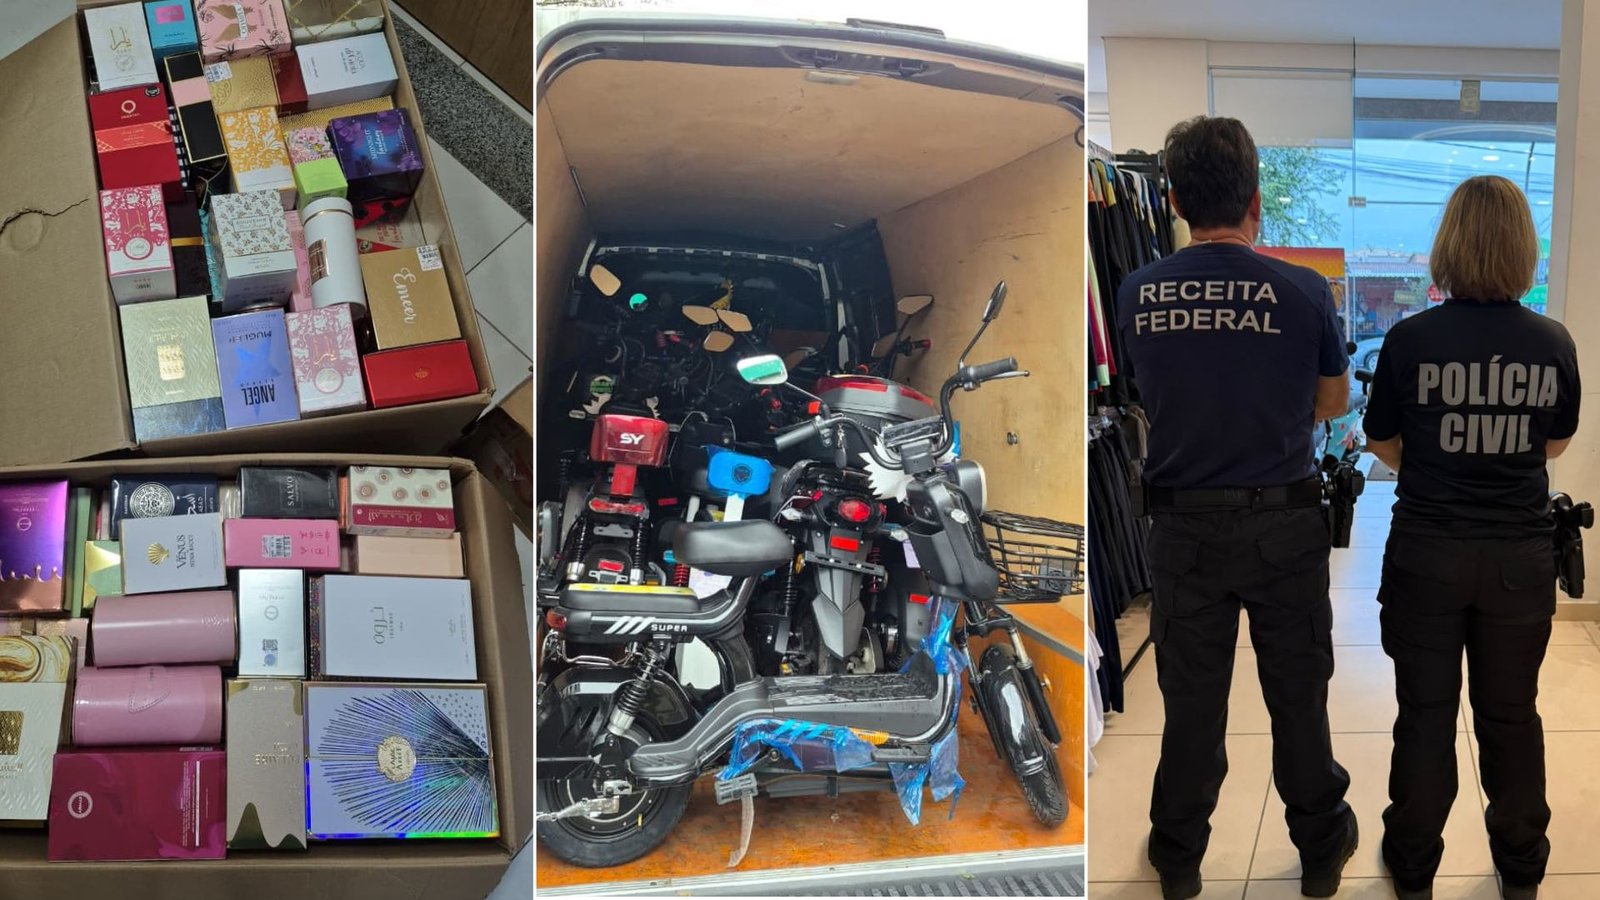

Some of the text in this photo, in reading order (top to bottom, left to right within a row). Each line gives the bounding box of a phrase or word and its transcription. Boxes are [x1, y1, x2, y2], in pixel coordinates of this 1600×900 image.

[392, 267, 417, 325] Emeer
[1139, 280, 1278, 304] RECEITA
[1135, 308, 1282, 335] FEDERAL
[1417, 354, 1558, 408] POLÍCIA
[241, 383, 276, 407] ANGEL
[619, 433, 645, 445] SY
[1439, 412, 1533, 454] CIVIL
[287, 475, 295, 506] SALVO
[651, 623, 688, 633] SUPER
